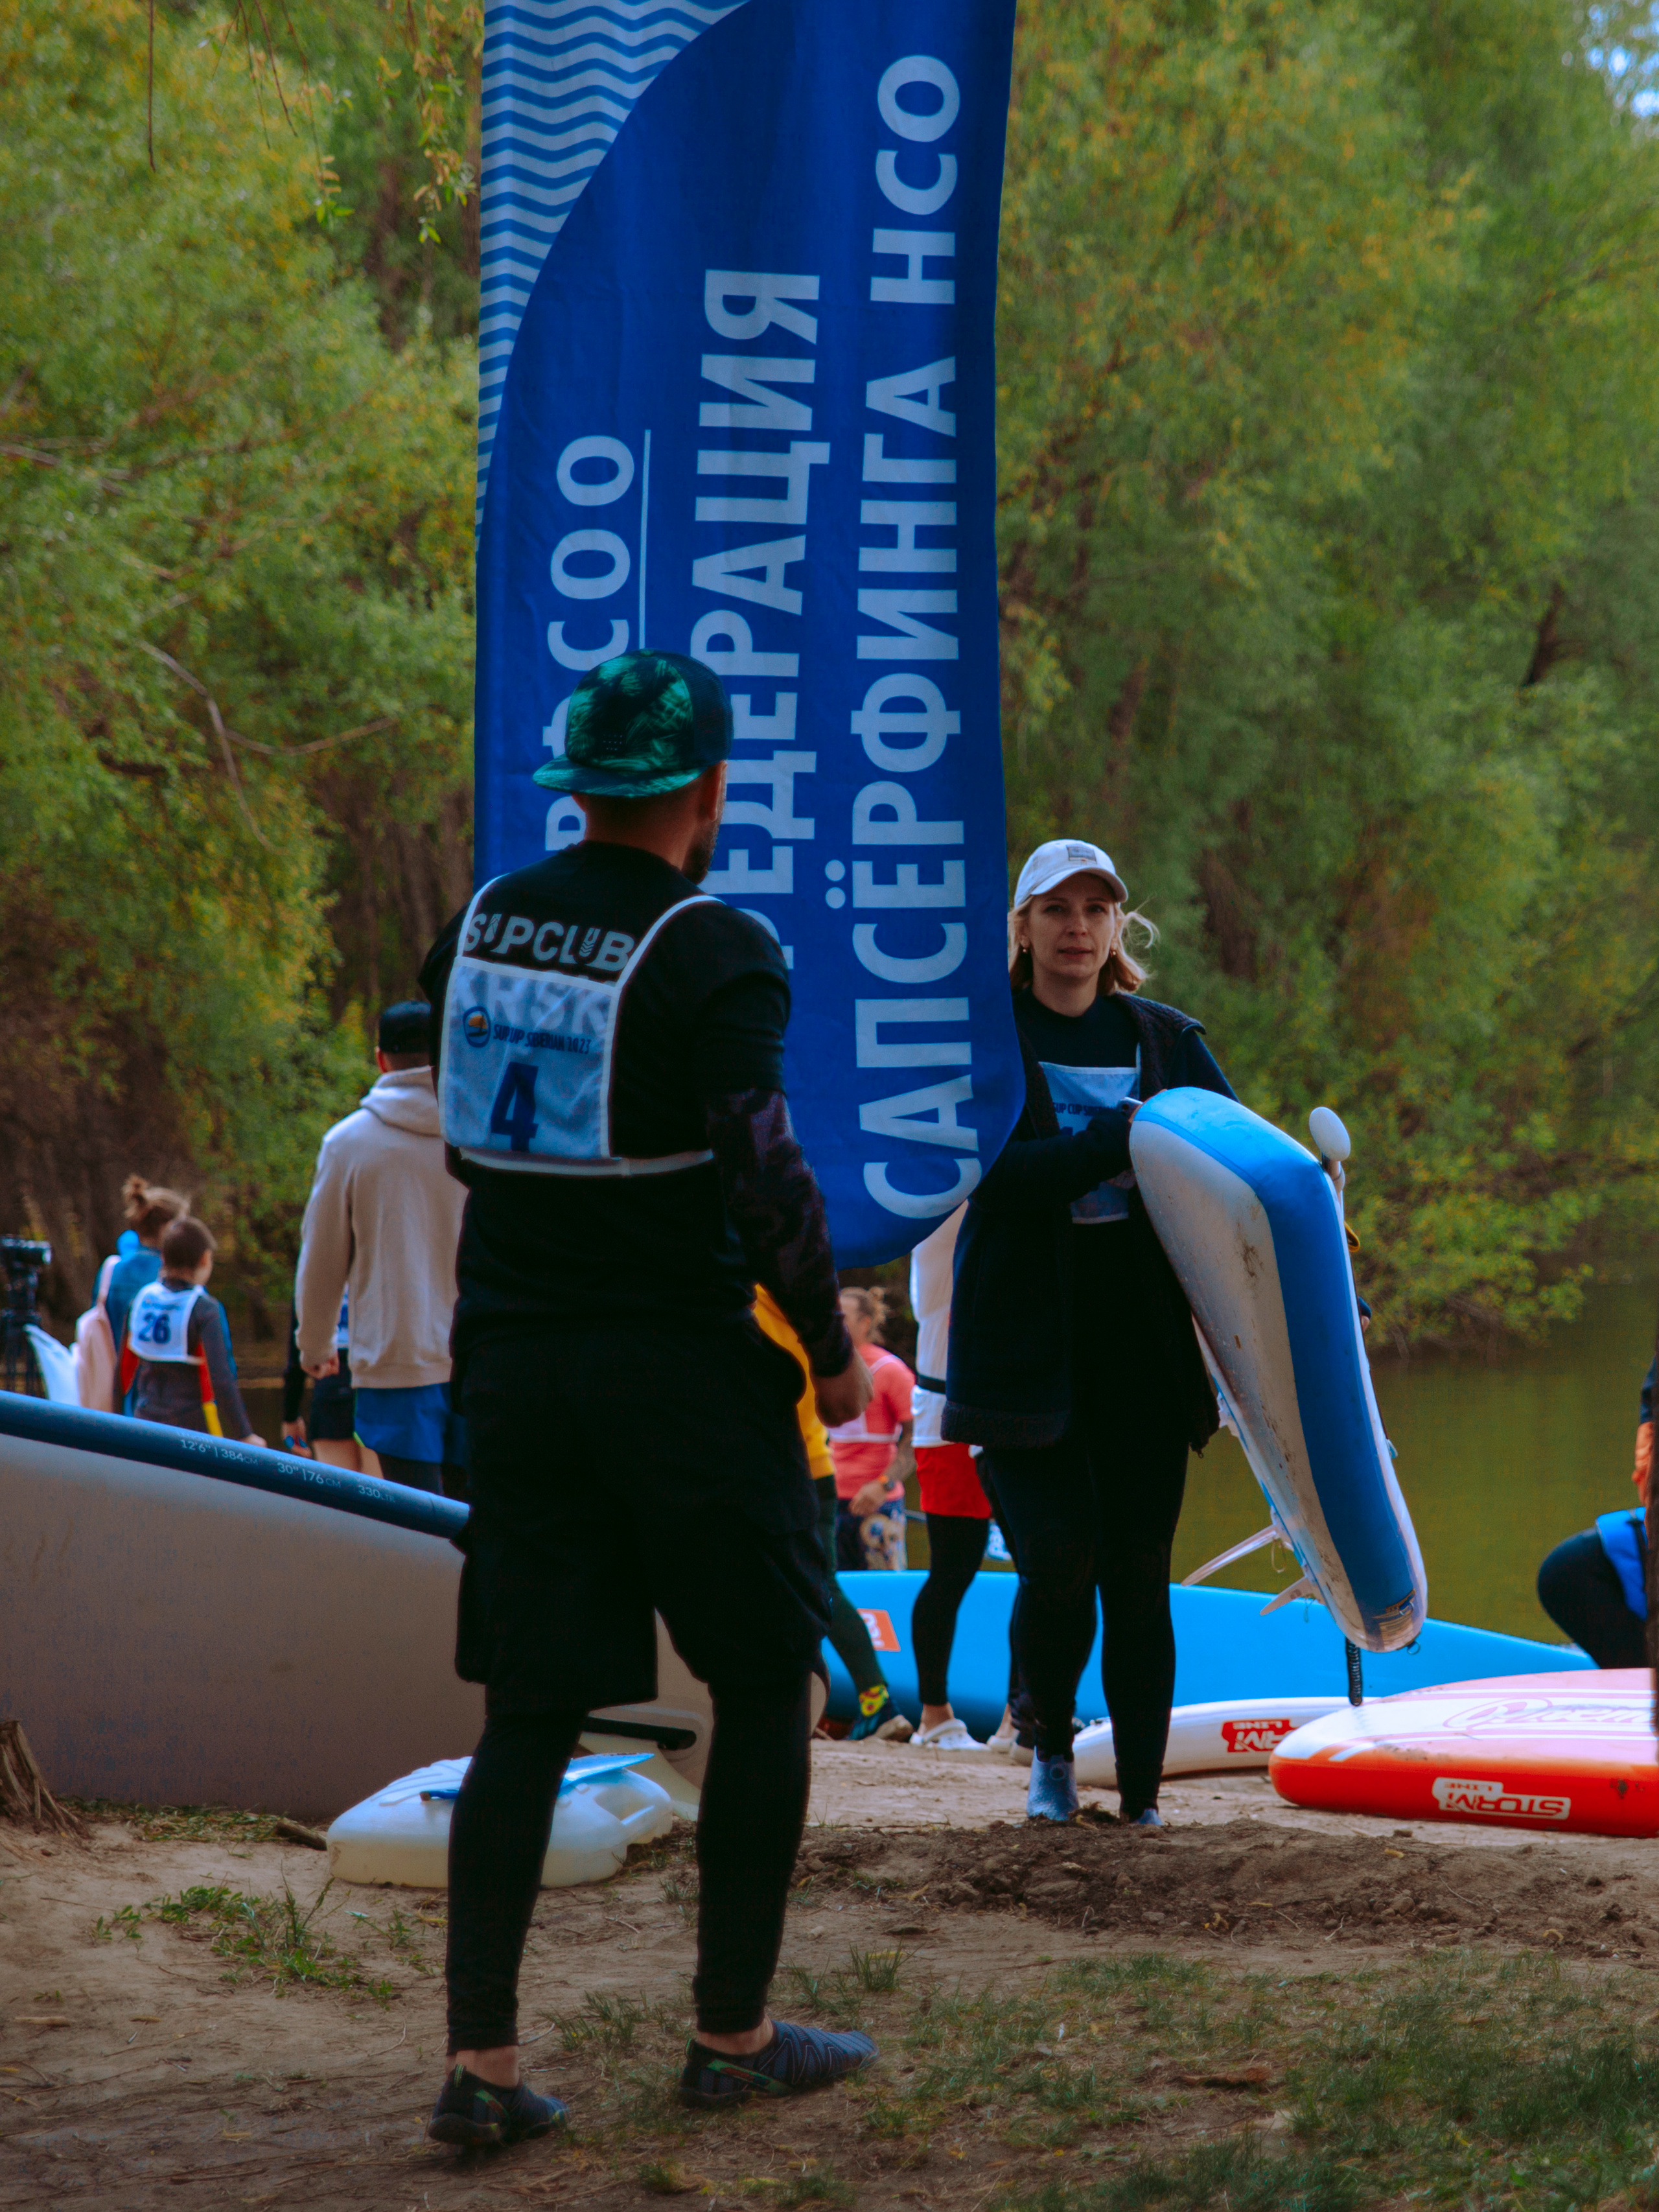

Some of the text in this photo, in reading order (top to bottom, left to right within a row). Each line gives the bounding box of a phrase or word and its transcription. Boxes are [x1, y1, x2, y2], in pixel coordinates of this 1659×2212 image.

[690, 269, 830, 969] ЕДЕРАЦИЯ
[825, 54, 982, 1218] САПСЁРФИНГА НСО
[493, 1024, 510, 1041] SUP
[564, 1036, 592, 1054] 2023
[491, 1062, 539, 1152] 4
[138, 1312, 171, 1344] 26
[1447, 1792, 1564, 1817] STORM
